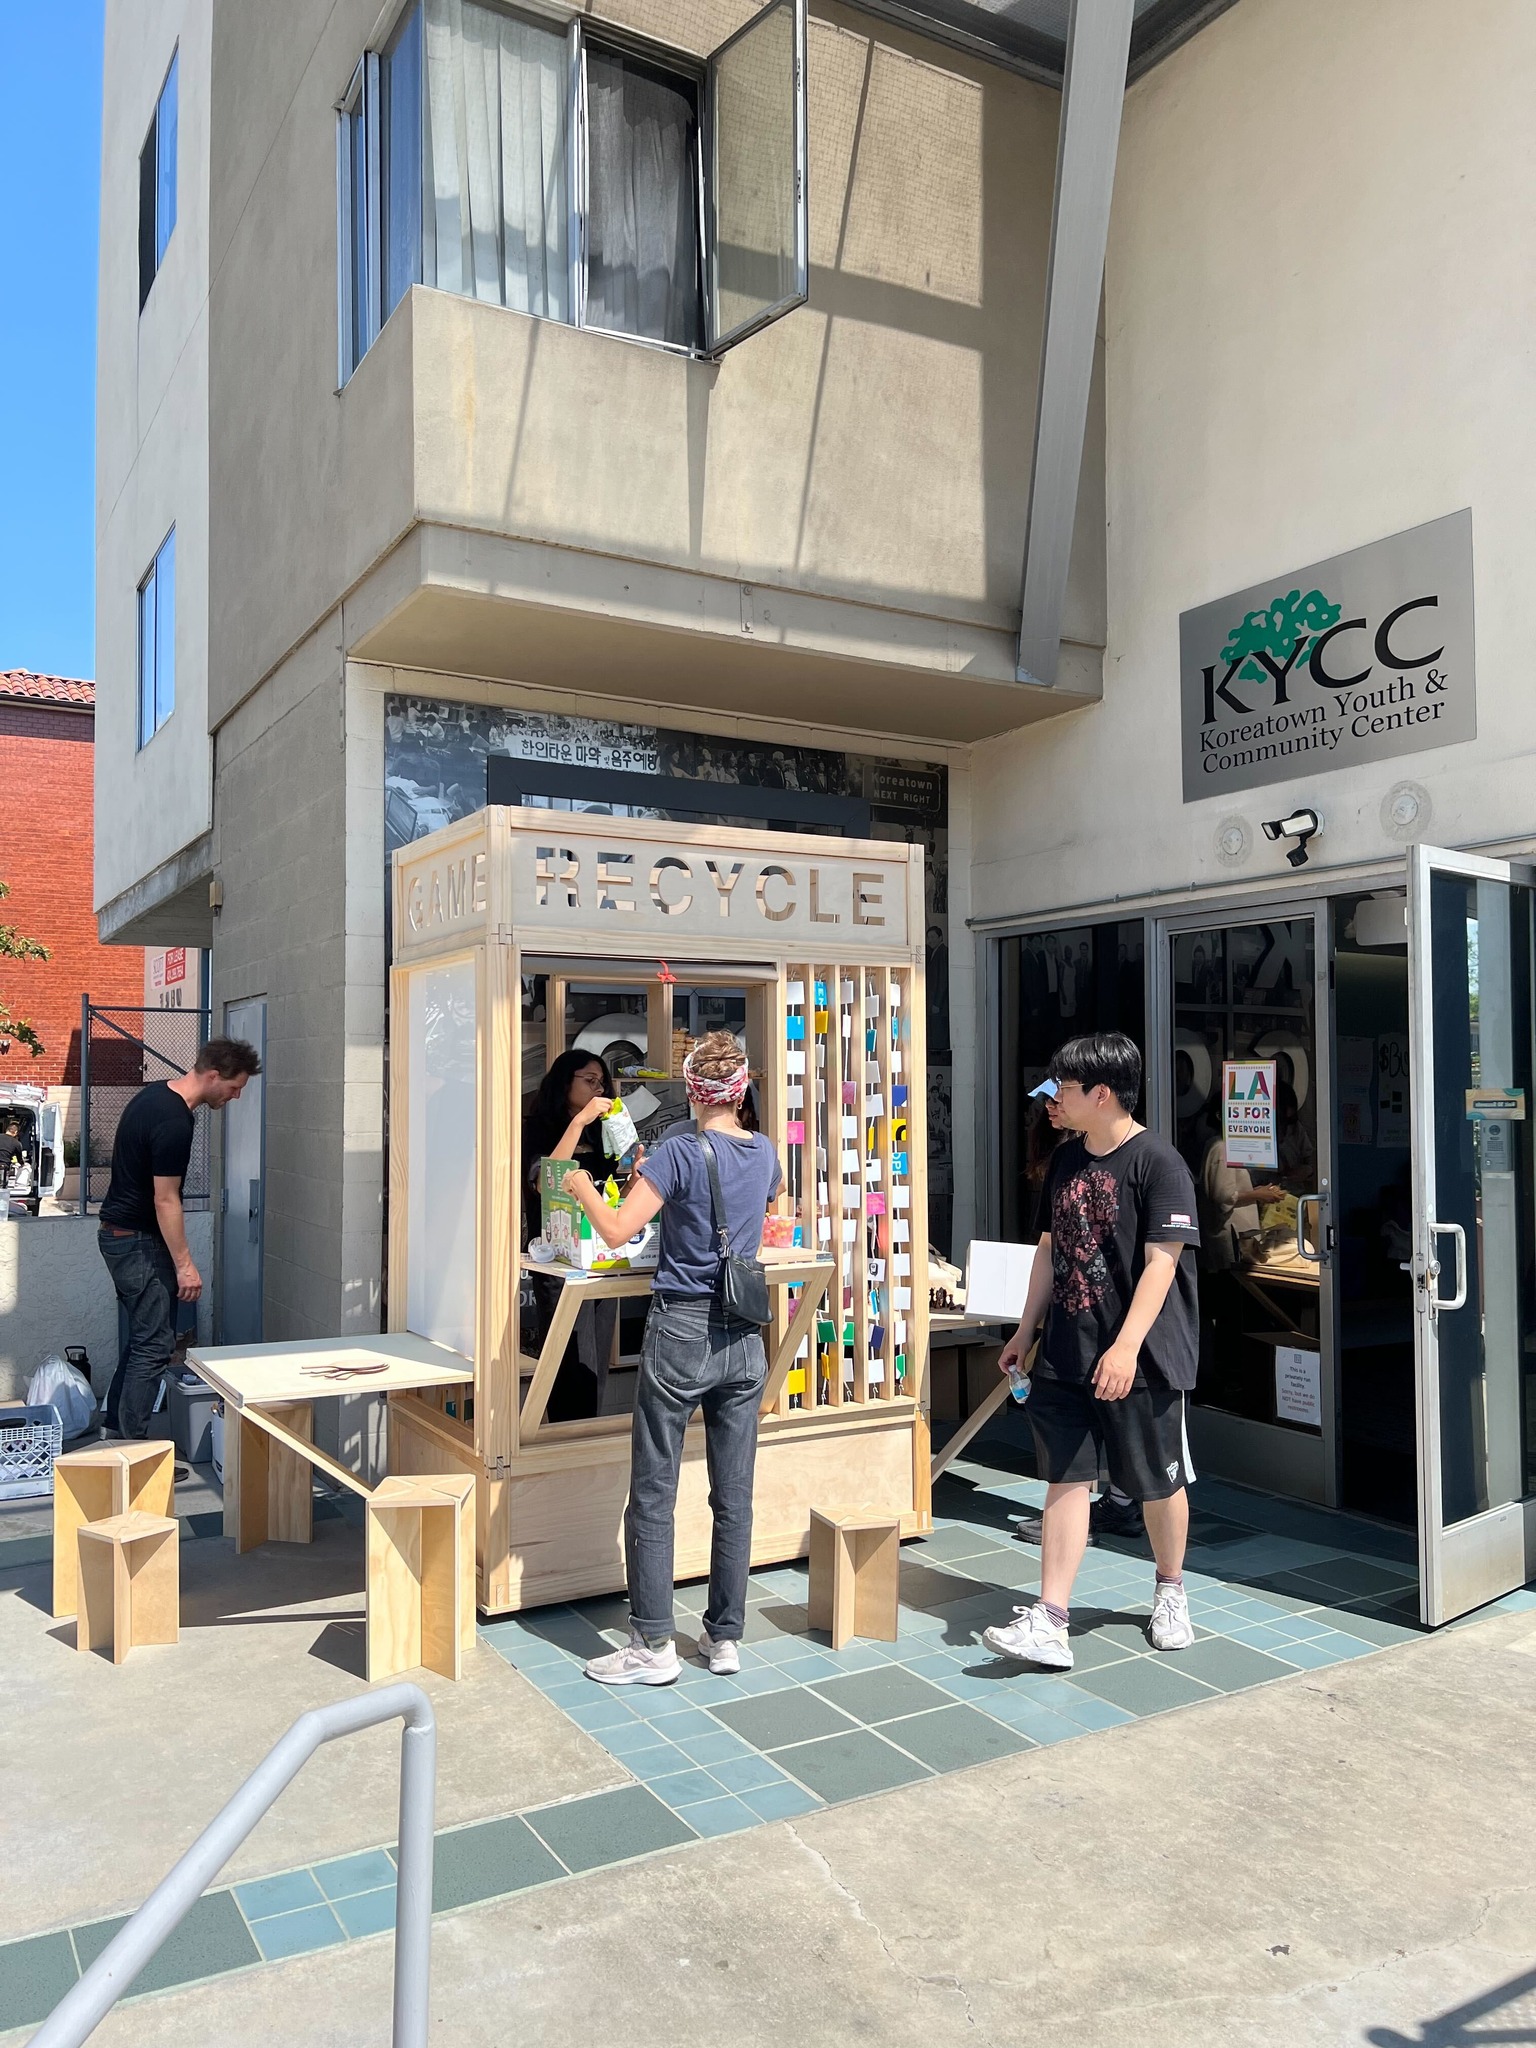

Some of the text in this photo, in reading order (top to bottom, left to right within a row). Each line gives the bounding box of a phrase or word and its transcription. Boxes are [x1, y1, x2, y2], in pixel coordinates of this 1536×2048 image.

[1200, 595, 1445, 726] KYCC
[1200, 668, 1449, 752] Koreatown Youth &
[521, 739, 572, 762] 한인타운
[575, 745, 601, 765] 마약
[1203, 701, 1446, 774] Community Center
[871, 771, 933, 791] Koreatown
[873, 790, 931, 804] NEXT RIGHT
[408, 853, 487, 931] GAME
[535, 846, 886, 926] RECYCLE
[1228, 1071, 1271, 1100] LA
[1228, 1106, 1271, 1119] IS FOR
[1228, 1124, 1271, 1134] EVERYONE
